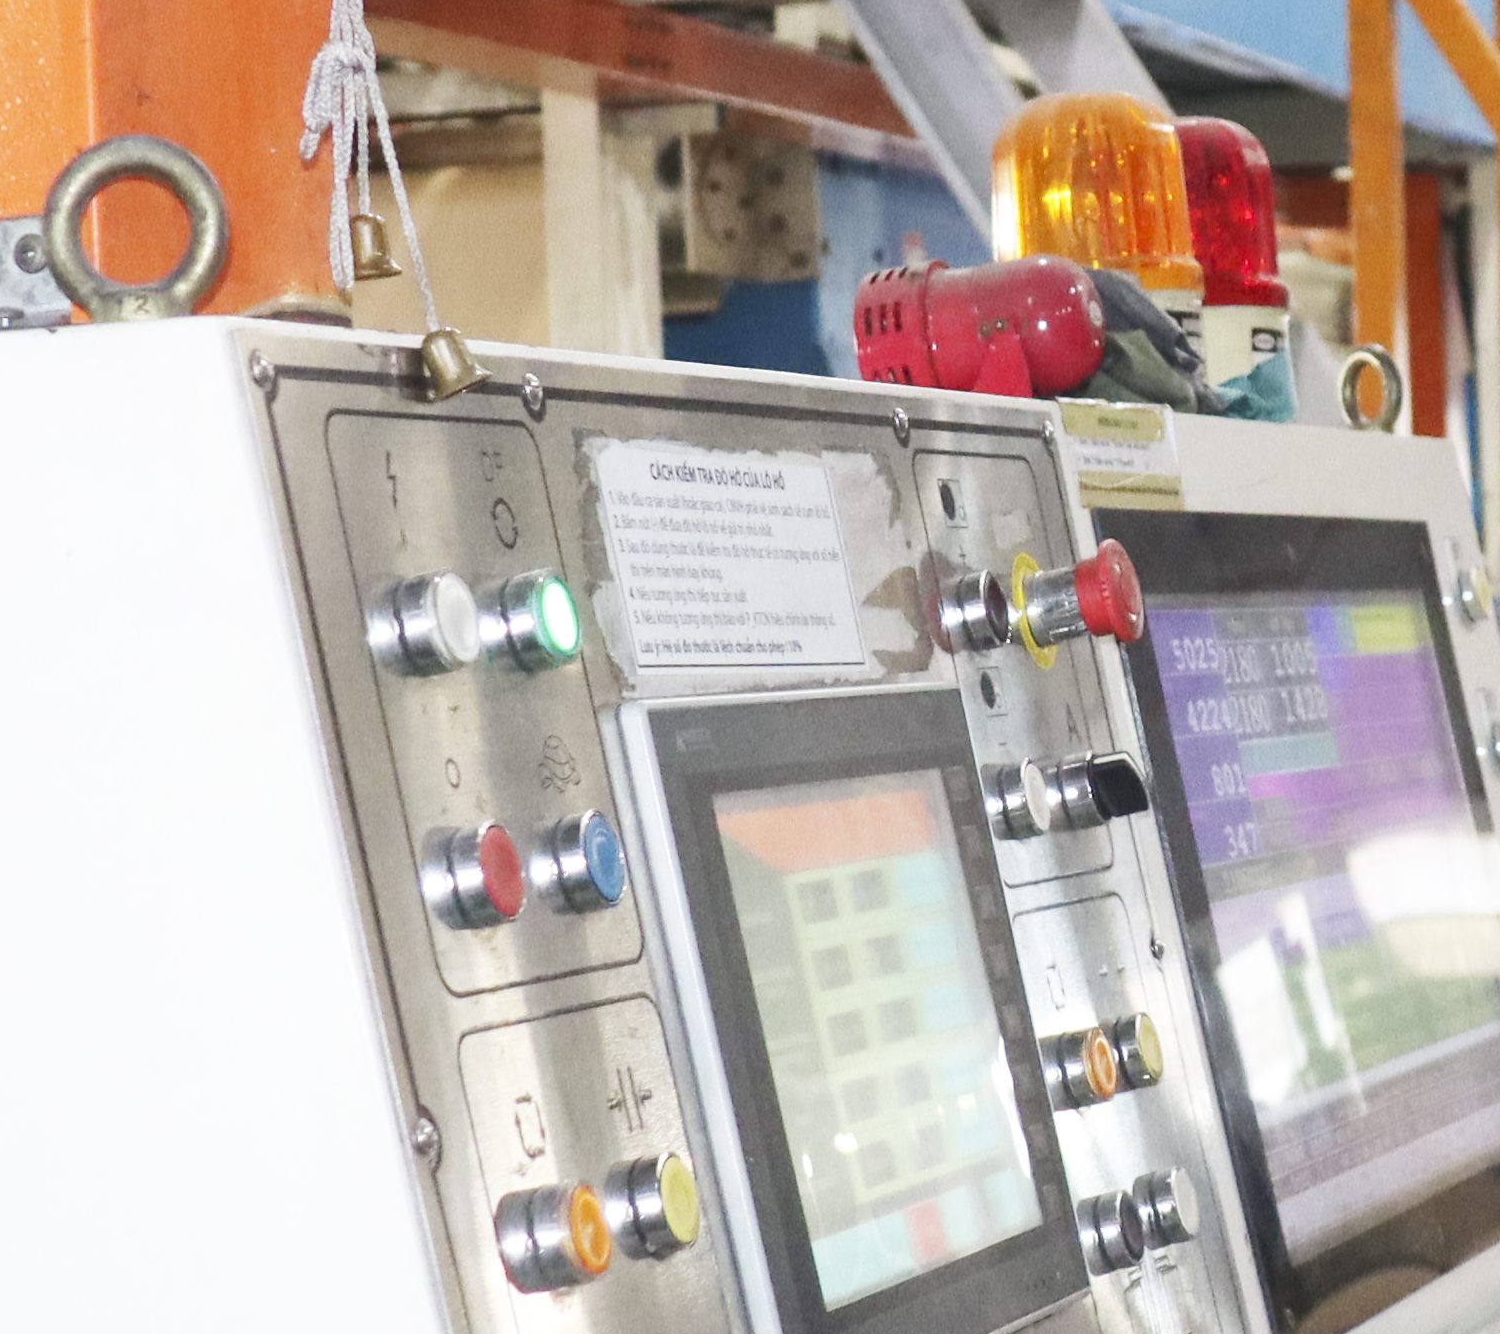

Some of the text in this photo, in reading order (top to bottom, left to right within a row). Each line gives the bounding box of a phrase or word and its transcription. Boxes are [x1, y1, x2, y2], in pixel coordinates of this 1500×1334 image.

[650, 458, 675, 481] CÁCH
[698, 466, 715, 484] TRA
[1171, 636, 1219, 672] 5025
[1187, 697, 1233, 733] 4224
[1224, 822, 1258, 858] 347
